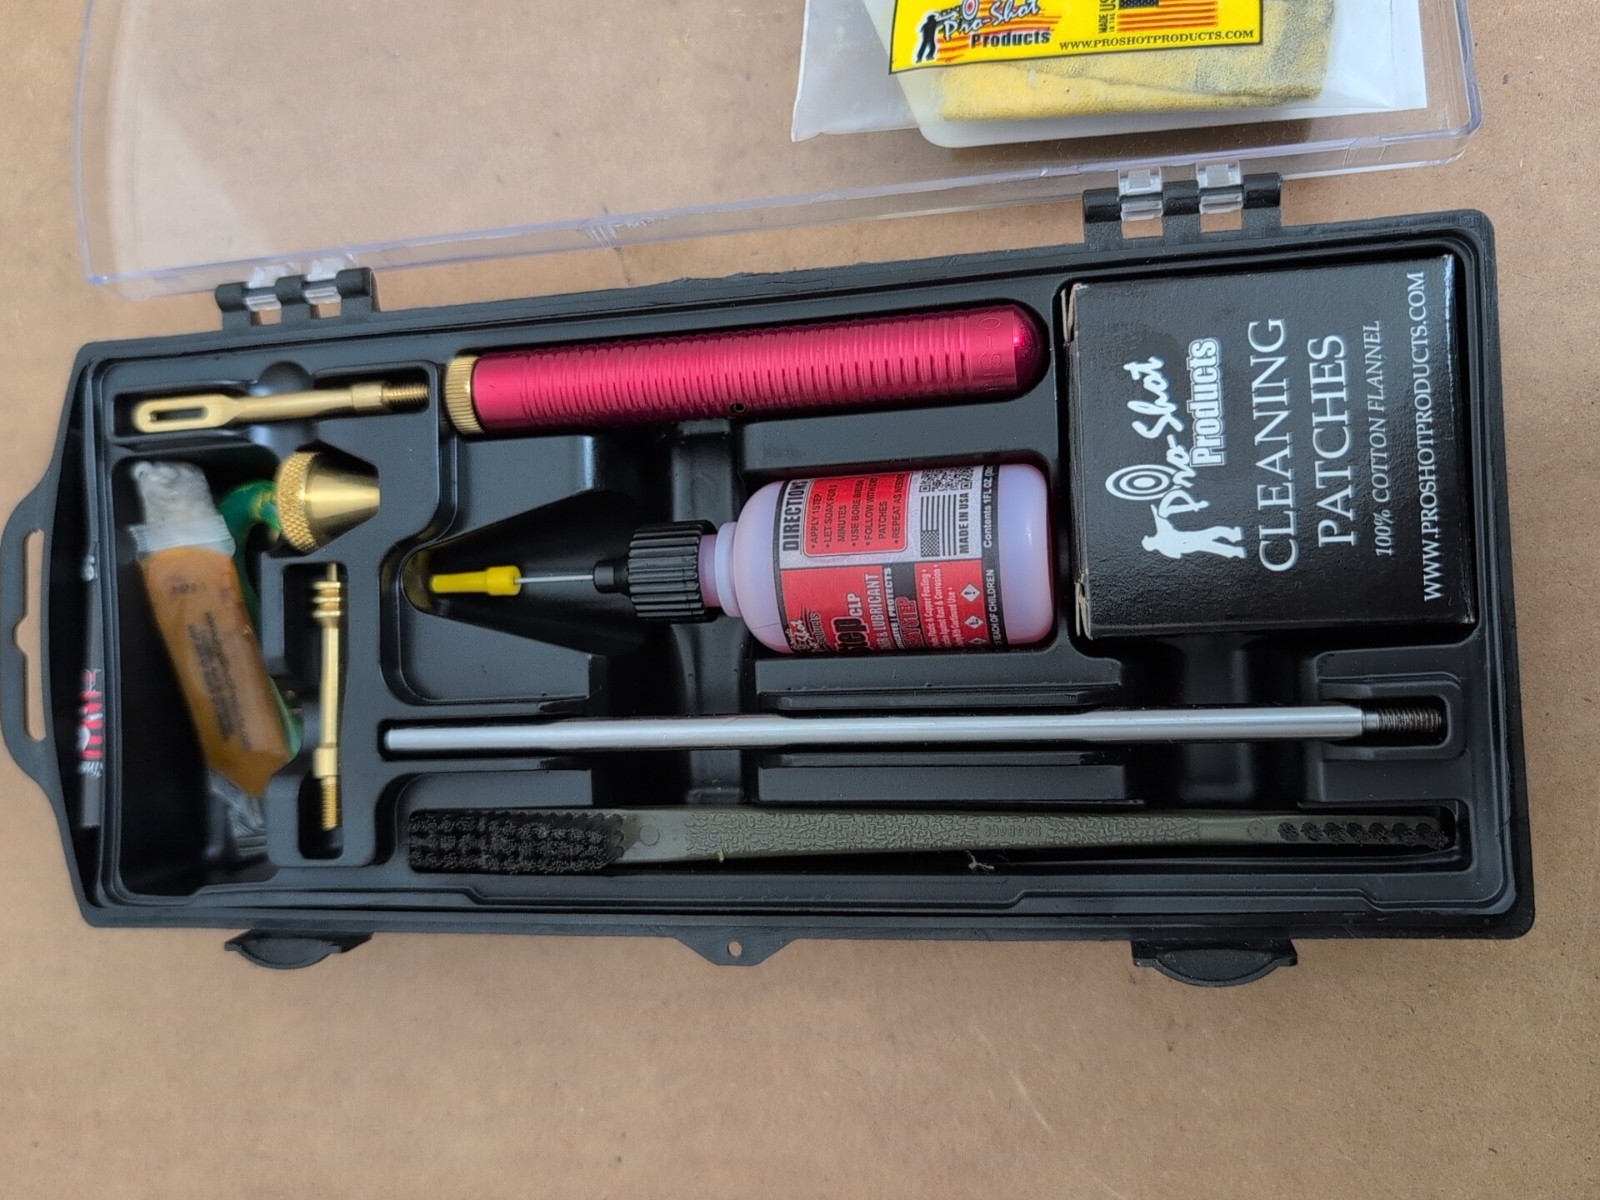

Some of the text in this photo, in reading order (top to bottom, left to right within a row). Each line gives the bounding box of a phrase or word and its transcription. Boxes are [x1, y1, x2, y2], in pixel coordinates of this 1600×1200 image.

[942, 0, 1040, 41] Pro-Shot
[1098, 13, 1109, 34] MADE
[970, 30, 1052, 49] Products
[1059, 30, 1255, 51] WWW.PROSHOTPRODUCTS.COM
[1185, 337, 1226, 467] Products
[1123, 356, 1209, 519] Pro-Shot
[1248, 318, 1298, 572] CLEANING
[1307, 335, 1357, 548] PATCHES
[1363, 320, 1394, 557] 100% COTTON FLANNEL
[1406, 271, 1443, 602] WWW.PROSHOTPRODUCTS.COM
[826, 489, 836, 501] FOR
[851, 499, 861, 521] BORE
[866, 486, 876, 503] WITH
[893, 493, 902, 504] AS
[782, 480, 808, 551] DIRECTIONS
[825, 502, 834, 524] SOAK
[838, 505, 847, 542] MINUTES
[864, 504, 873, 540] FOLLOW
[878, 501, 888, 540] PATCHES
[891, 505, 901, 539] REPEAT
[958, 492, 969, 554] MADE IN USA
[983, 504, 993, 548] Contents
[810, 516, 820, 543] APPLY
[824, 525, 833, 543] LET
[851, 523, 860, 541] USE
[883, 567, 896, 617] PROTECTS
[920, 573, 932, 597] Fouling
[932, 568, 943, 600] Corrosion
[946, 591, 956, 603] Use
[985, 569, 997, 612] CHILDREN
[847, 592, 863, 617] CLP
[865, 573, 887, 630] LUBRICANT
[895, 596, 920, 628] STEP
[923, 597, 934, 617] Copper
[989, 613, 999, 623] OF
